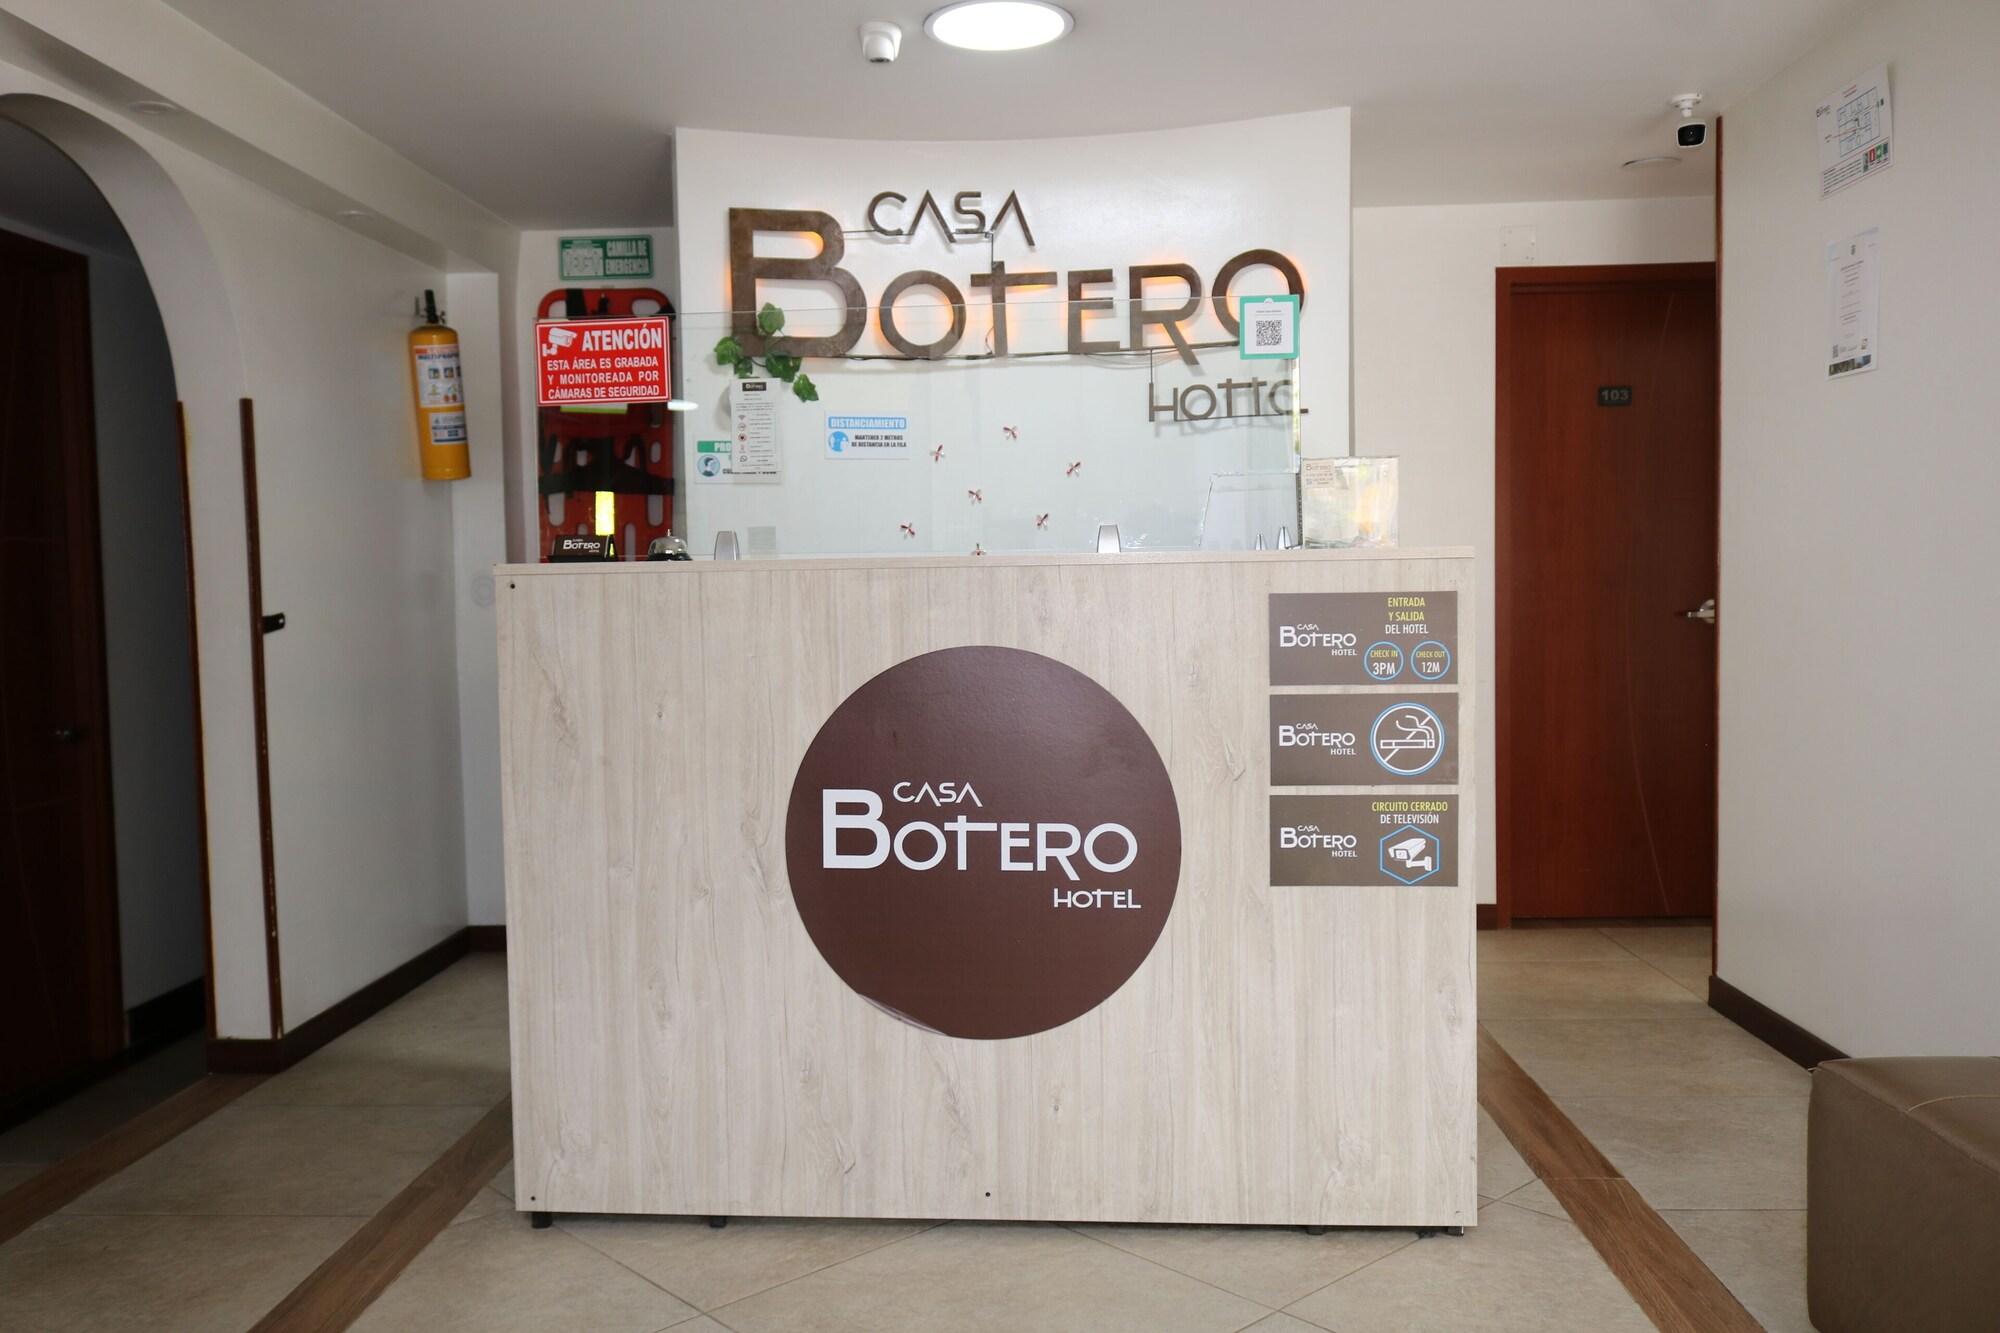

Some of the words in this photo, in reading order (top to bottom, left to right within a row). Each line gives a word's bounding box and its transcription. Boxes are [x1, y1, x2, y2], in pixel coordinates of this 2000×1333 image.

[866, 190, 1035, 247] CASA
[582, 323, 662, 352] ATENCIÓN
[547, 360, 570, 371] ESTA
[573, 357, 597, 370] ÁREA
[600, 359, 611, 369] ES
[615, 356, 658, 369] GRABADA
[548, 375, 554, 385] Y
[560, 372, 632, 385] MONITOREADA
[639, 371, 659, 381] POR
[548, 387, 592, 400] CÁMARAS
[594, 387, 606, 398] DE
[608, 385, 660, 397] SEGURIDAD
[1601, 390, 1629, 401] 103
[831, 419, 905, 429] DISTANCIAMIENTO
[1388, 597, 1425, 607] ENTRADA
[1388, 612, 1394, 621] Y
[1396, 611, 1425, 622] SALIDA
[1297, 623, 1319, 631] CASA
[1385, 624, 1401, 634] DEL
[1403, 623, 1429, 634] HOTEL
[1370, 650, 1390, 658] CHECK
[1391, 650, 1398, 658] IN
[1433, 650, 1446, 658] OUT
[1373, 662, 1396, 675] 3PM
[1421, 661, 1441, 673] 12M
[893, 781, 984, 807] CASA
[1371, 801, 1409, 812] CIRCUITO
[1410, 801, 1448, 812] CERRADO
[1380, 814, 1391, 824] DE
[1393, 812, 1439, 824] TELEVISIÓN
[1332, 850, 1358, 858] HOTEL
[1053, 888, 1142, 909] HOTEL
